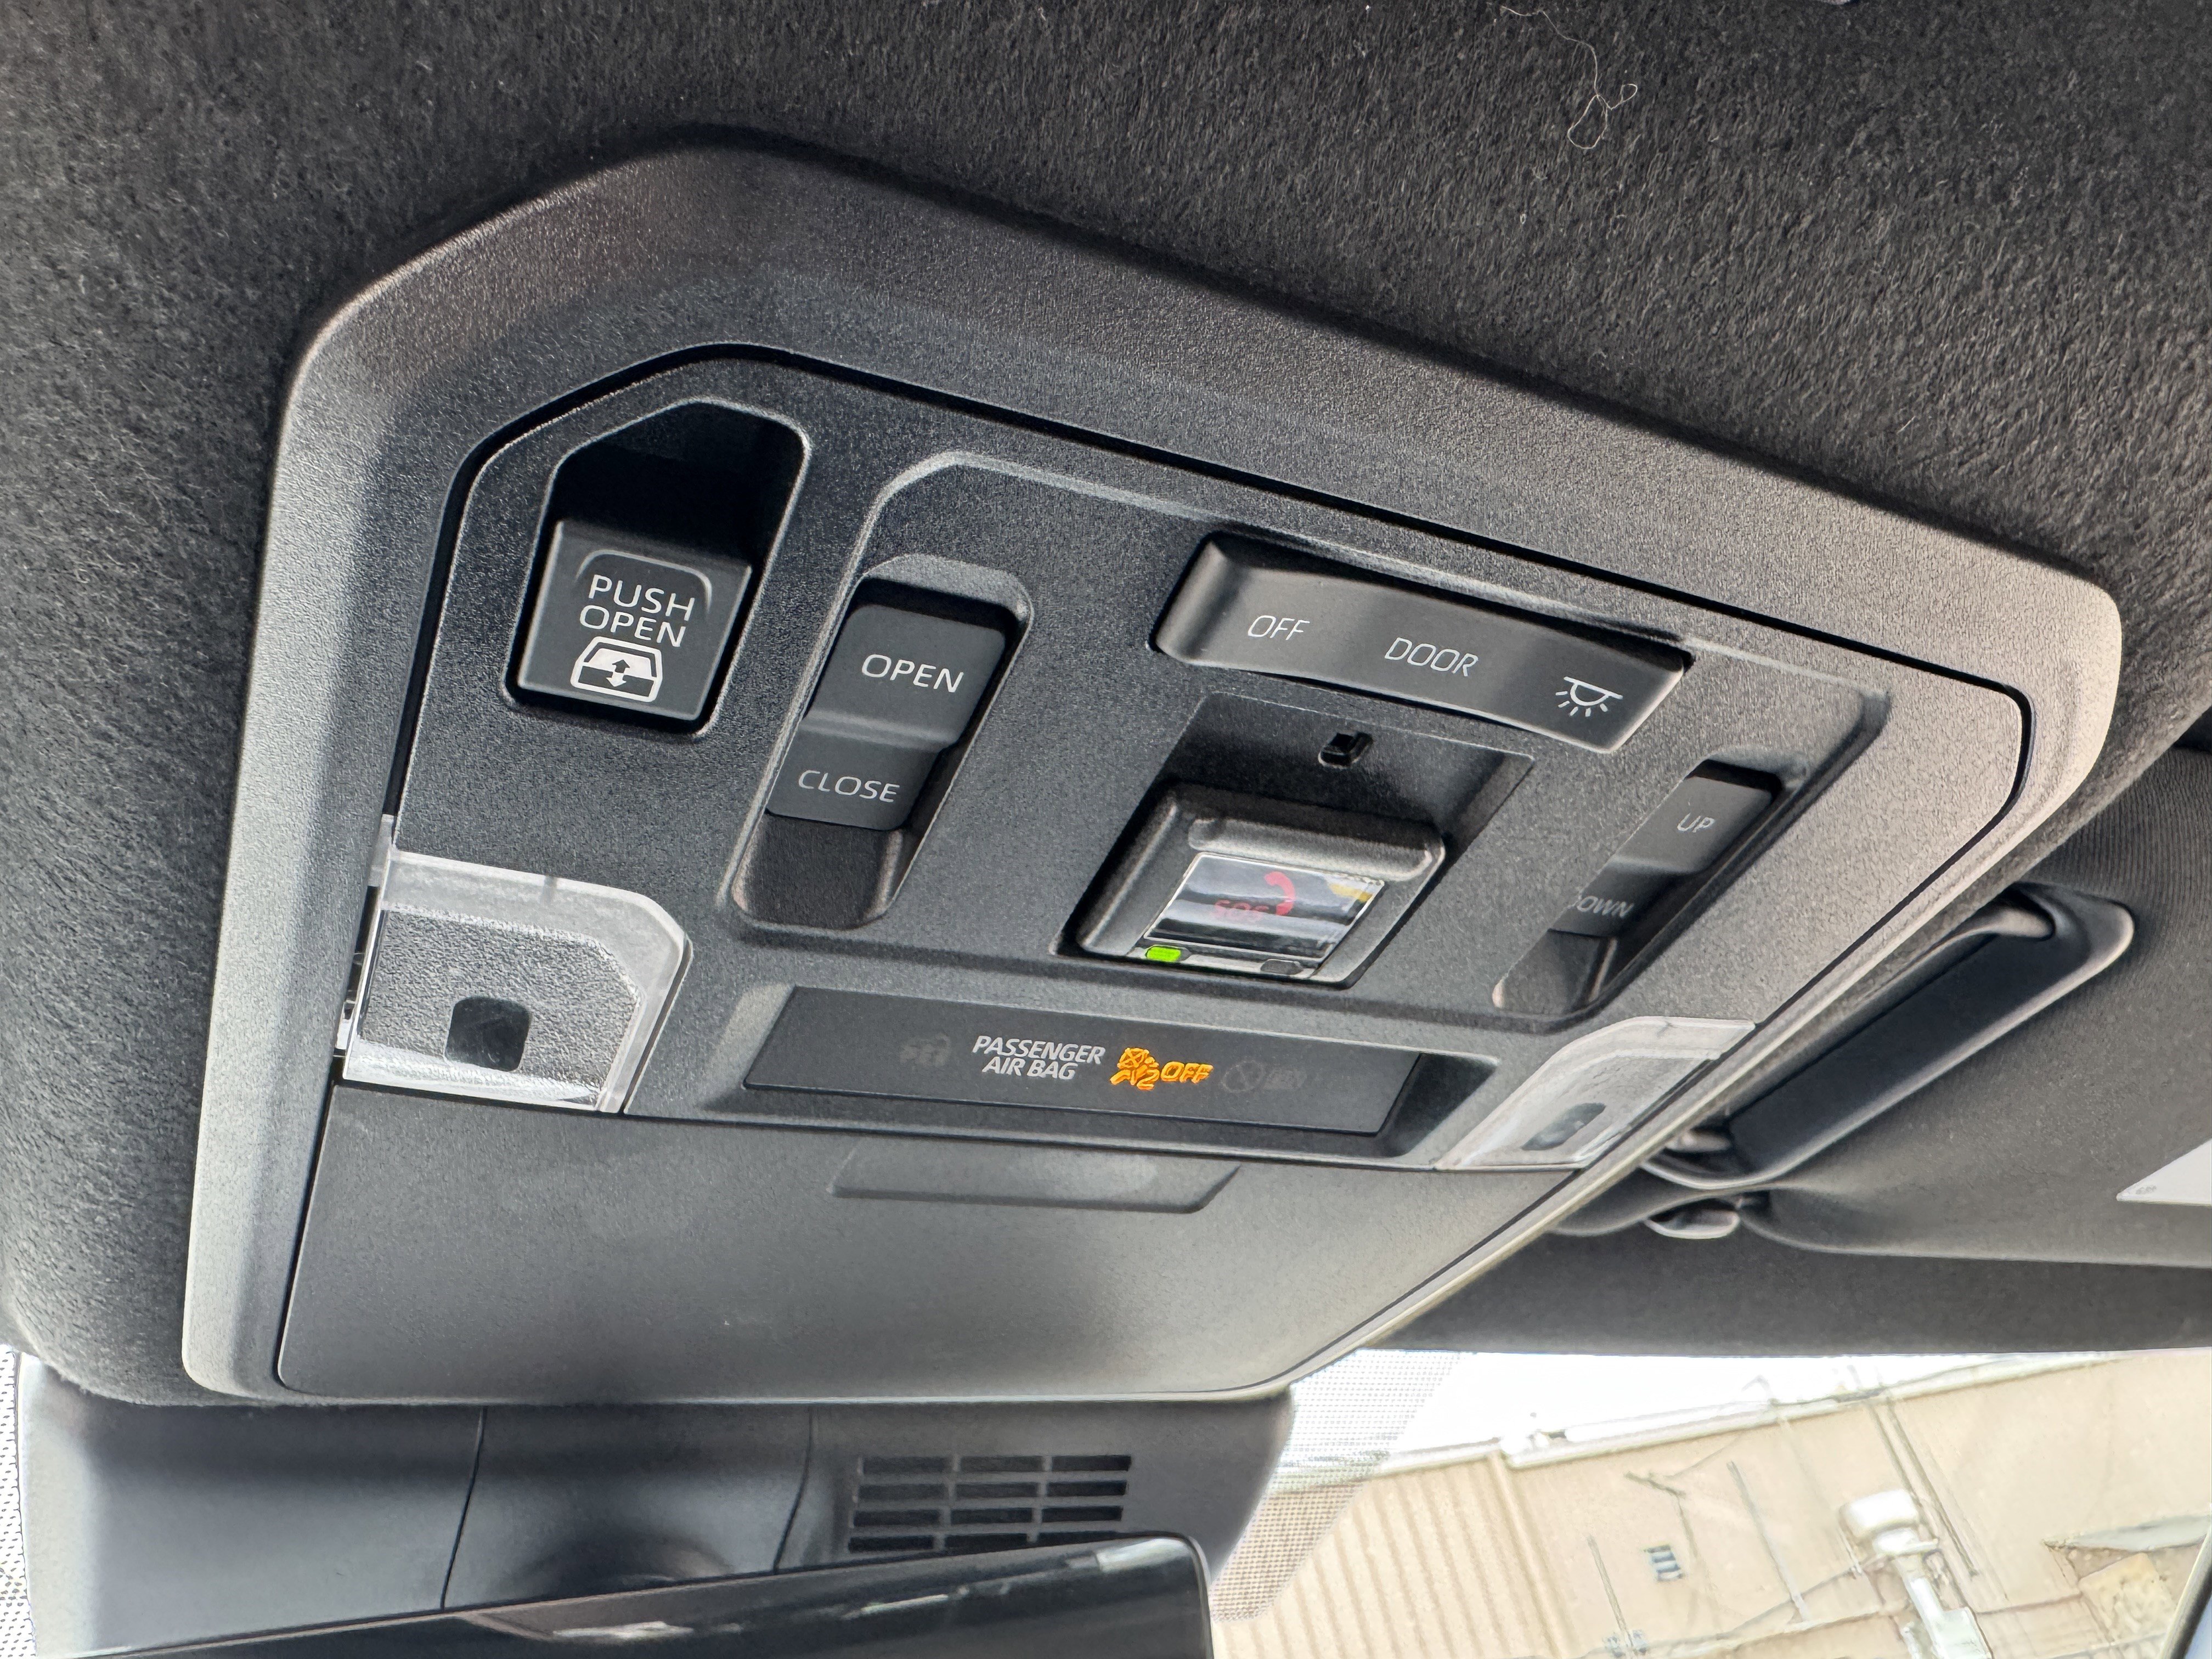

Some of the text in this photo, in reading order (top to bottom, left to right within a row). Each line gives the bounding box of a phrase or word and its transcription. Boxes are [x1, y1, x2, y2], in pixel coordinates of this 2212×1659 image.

[588, 574, 695, 622] PUSH
[579, 605, 686, 648] OPEN
[1247, 614, 1310, 641] OFF
[1384, 637, 1479, 677] DOOR
[862, 653, 964, 693] OPEN
[798, 769, 900, 803] CLOSE
[1677, 811, 1716, 833] UP
[1576, 895, 1634, 918] OWN
[972, 1035, 1106, 1065] PASSENGER
[982, 1056, 1079, 1080] AIR BAG
[1160, 1061, 1215, 1084] OFF
